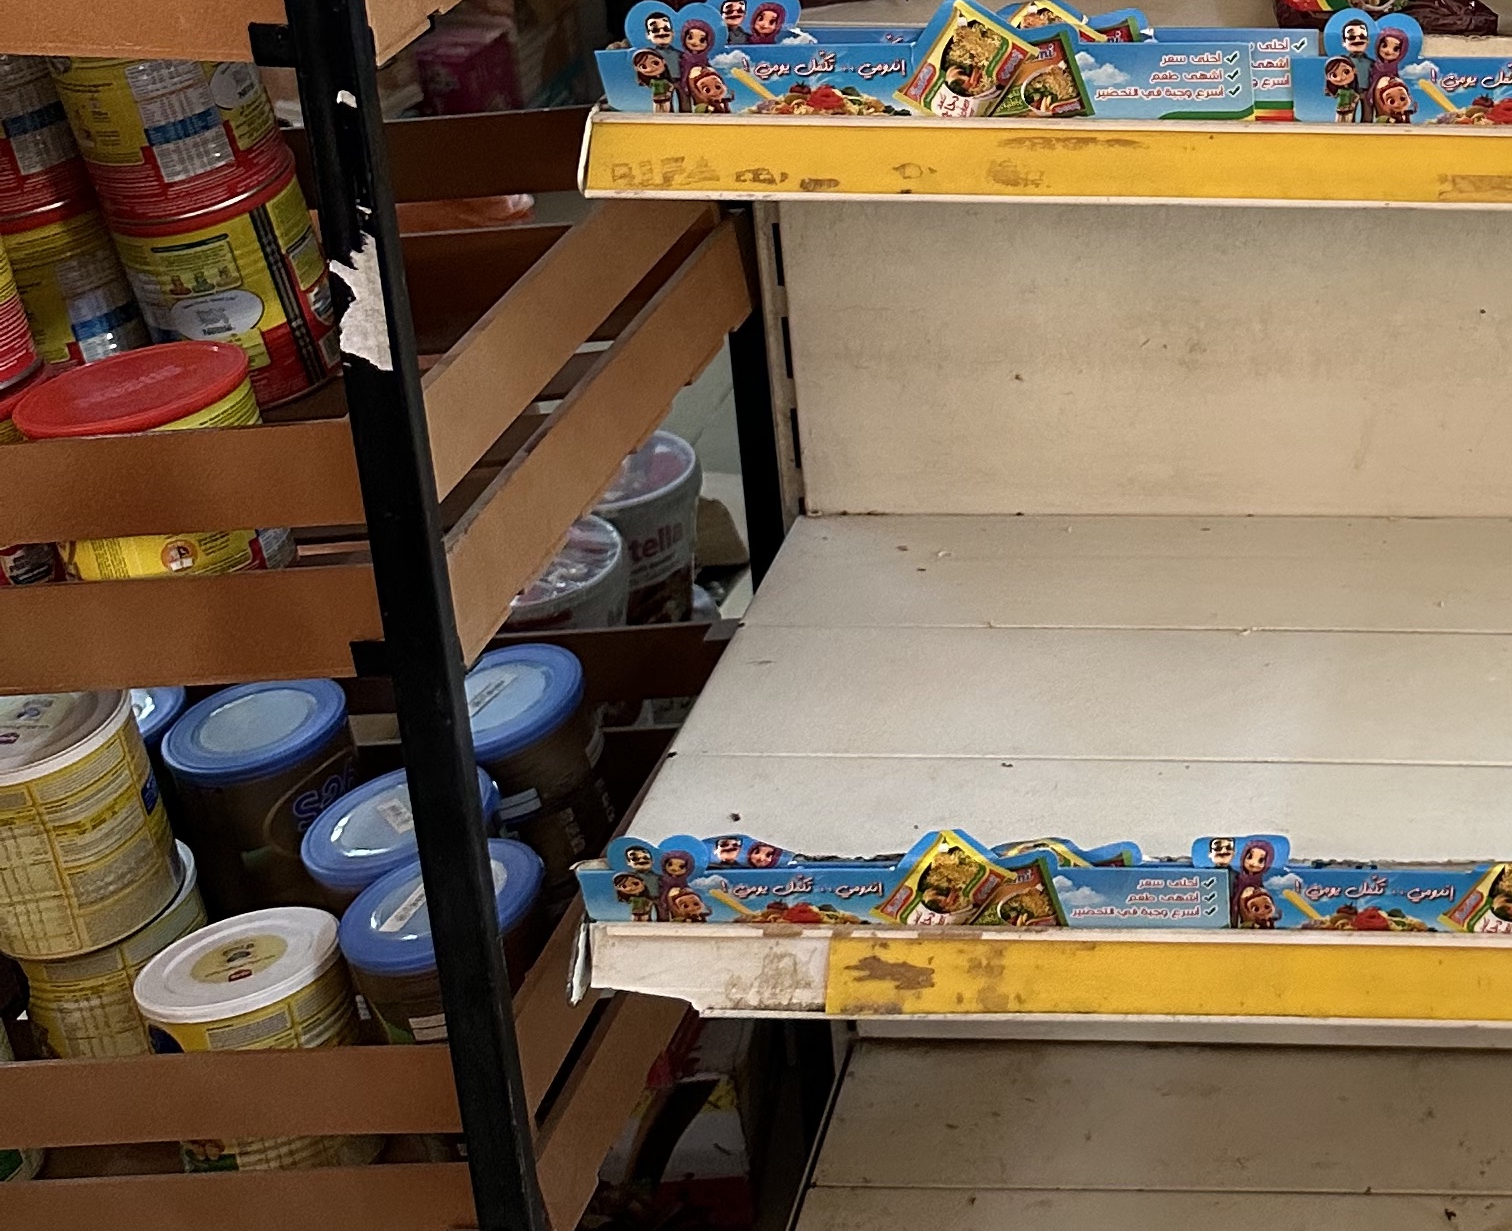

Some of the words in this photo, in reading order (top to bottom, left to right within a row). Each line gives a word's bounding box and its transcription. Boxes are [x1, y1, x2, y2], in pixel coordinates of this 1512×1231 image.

[1160, 54, 1187, 66] سعر
[1150, 71, 1180, 83] طعم
[1095, 87, 1139, 100] التحضير
[1141, 88, 1162, 101] في
[1165, 88, 1193, 101] وجبة
